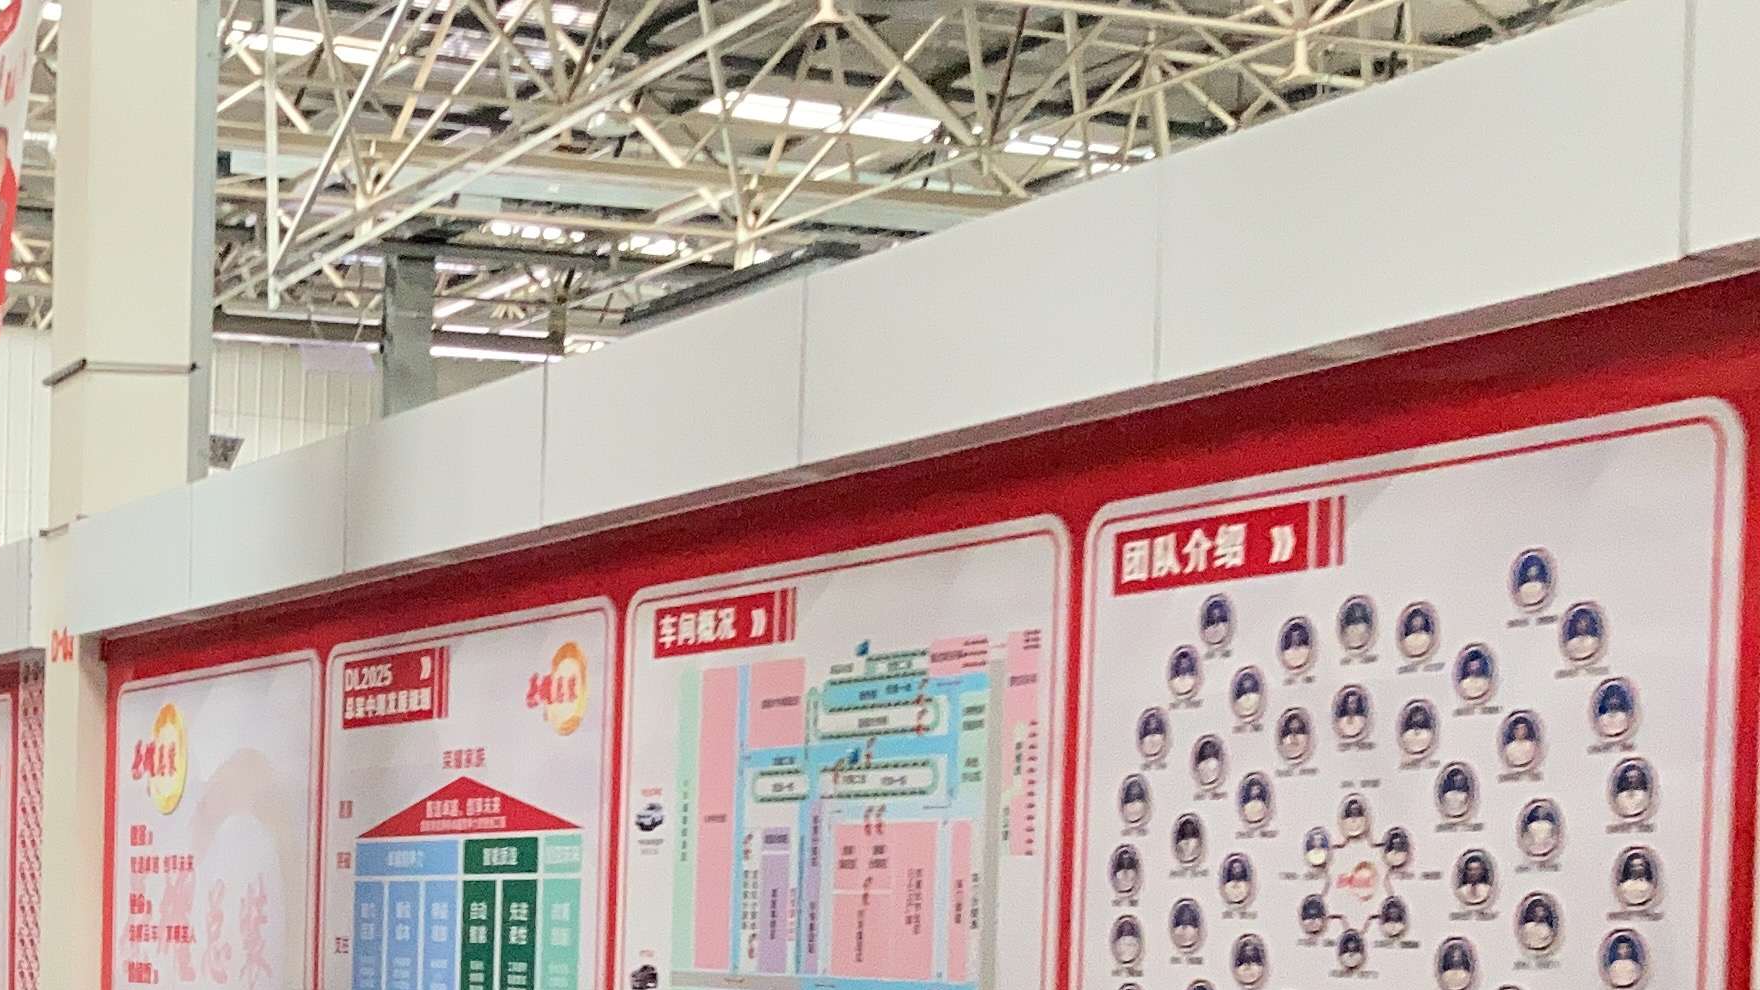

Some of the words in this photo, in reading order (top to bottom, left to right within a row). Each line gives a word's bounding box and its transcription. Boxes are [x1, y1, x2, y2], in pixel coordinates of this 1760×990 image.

[1121, 523, 1247, 583] 团队介绍
[659, 607, 737, 648] 车间概况
[345, 661, 393, 693] DL2025
